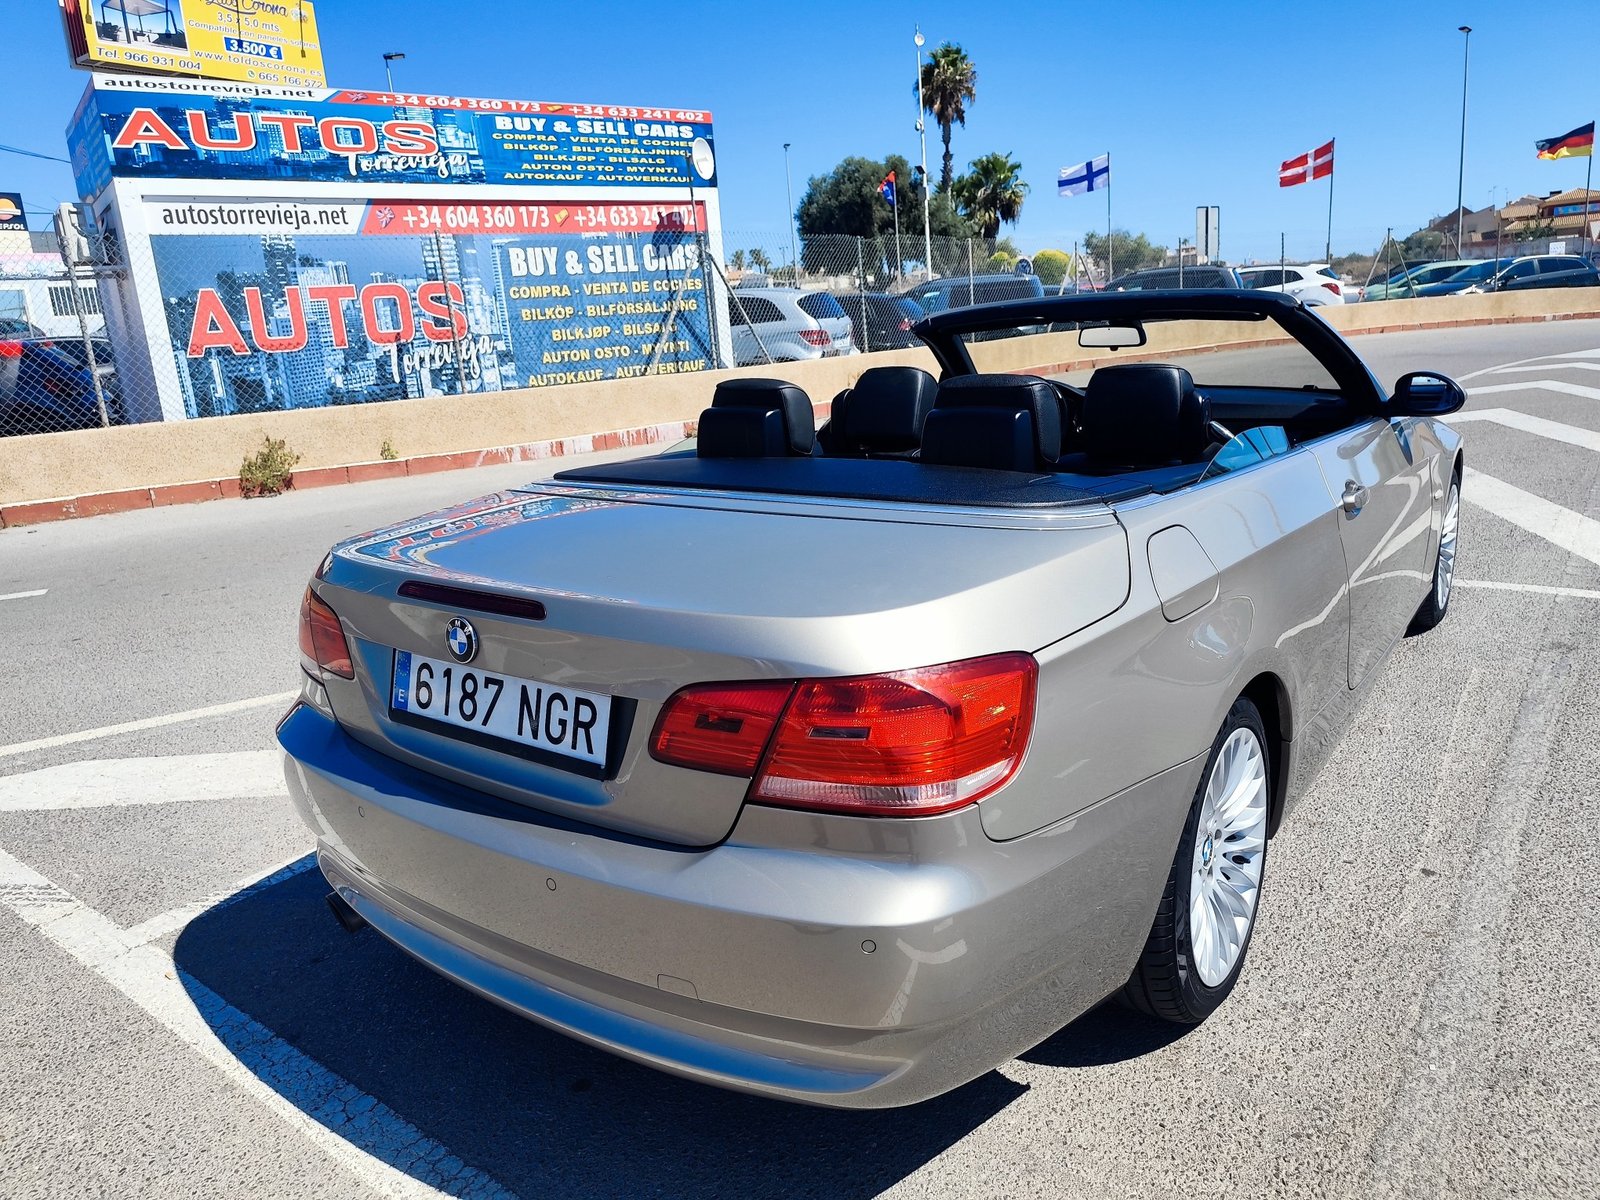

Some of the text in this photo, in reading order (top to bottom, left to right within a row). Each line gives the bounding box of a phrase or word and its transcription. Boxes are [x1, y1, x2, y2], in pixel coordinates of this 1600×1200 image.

[217, 12, 232, 23] 3,5
[244, 17, 258, 27] 5,0
[188, 20, 237, 35] Compatible
[257, 32, 288, 44] paneles
[96, 47, 202, 70] Tel. 966 931 004
[230, 41, 279, 58] 3.500 €
[194, 50, 322, 77] www.toldoscorona.es
[104, 79, 316, 98] autostorrevieja.net
[258, 72, 323, 89] 665 166 572
[376, 93, 704, 121] +34 604 360 173 +34 633 241 402
[112, 106, 439, 157] AUTOS
[494, 115, 694, 139] BUY & SELL CARS
[492, 132, 557, 142] COMPRA
[570, 135, 617, 145] VENTA
[621, 137, 639, 146] DE
[503, 142, 559, 151] BILKÖP
[346, 151, 467, 178] Torrevieja
[521, 163, 573, 171] AUTON
[576, 164, 614, 172] OSTO
[626, 166, 678, 174] MYYNTI
[533, 153, 596, 162] BILKJØP
[608, 156, 666, 165] BILSALG
[503, 172, 584, 181] AUTOKAUF
[162, 204, 349, 230] autostorrevieja.net
[402, 205, 695, 228] +34 604 360 173 +34 633 241 402
[508, 243, 700, 277] BUY & SELL CARS
[509, 284, 571, 299] COMPRA
[583, 282, 629, 296] VENTA
[632, 281, 649, 293] DE
[187, 280, 469, 358] AUTOS
[521, 304, 574, 321] BILKÖP
[552, 326, 611, 342] BILKJØP
[384, 334, 494, 384] Torreveja
[542, 349, 591, 364] AUTON
[594, 345, 630, 360] OSTO
[528, 370, 604, 388] AUTOKAUF
[447, 620, 471, 635] BMW
[398, 688, 405, 702] E
[416, 663, 598, 755] 6187 NGR
